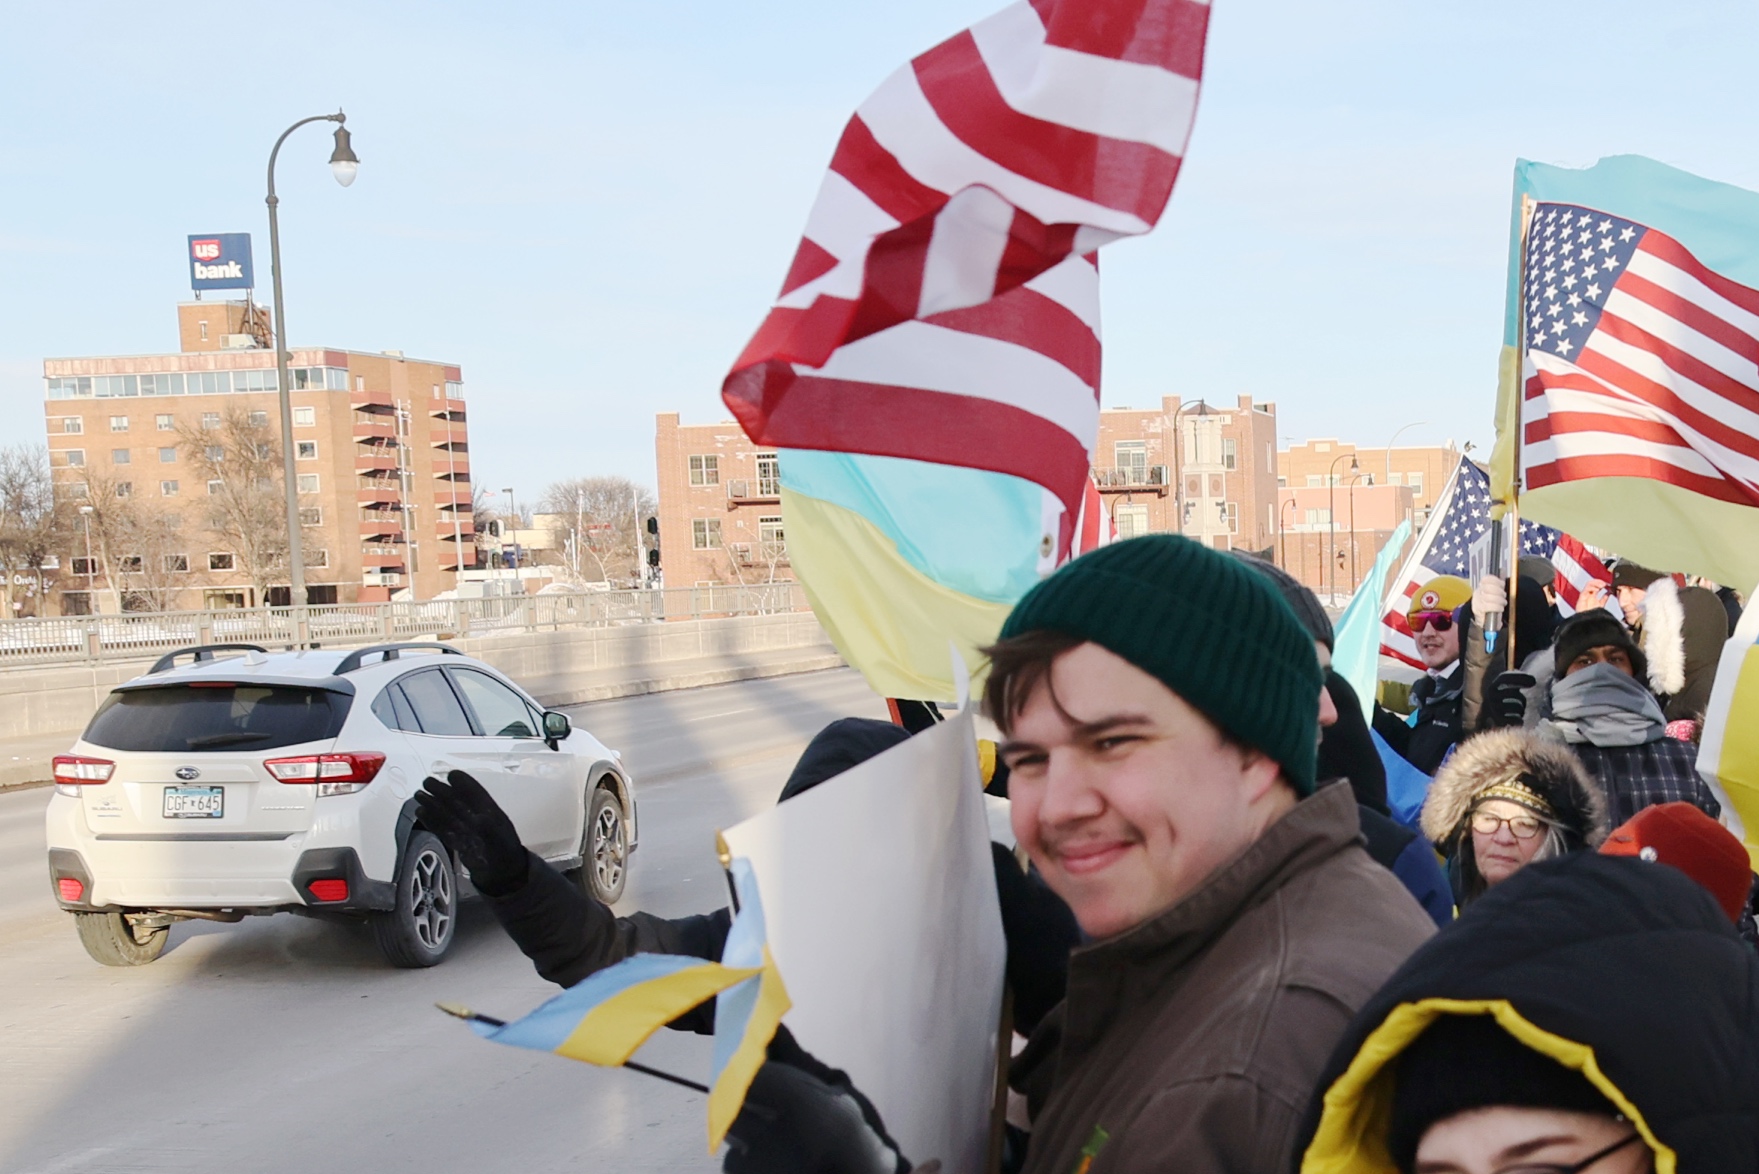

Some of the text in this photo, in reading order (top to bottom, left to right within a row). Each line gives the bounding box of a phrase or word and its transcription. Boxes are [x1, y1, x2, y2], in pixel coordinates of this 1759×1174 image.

[193, 260, 243, 280] bank
[167, 796, 220, 811] CGF 645
